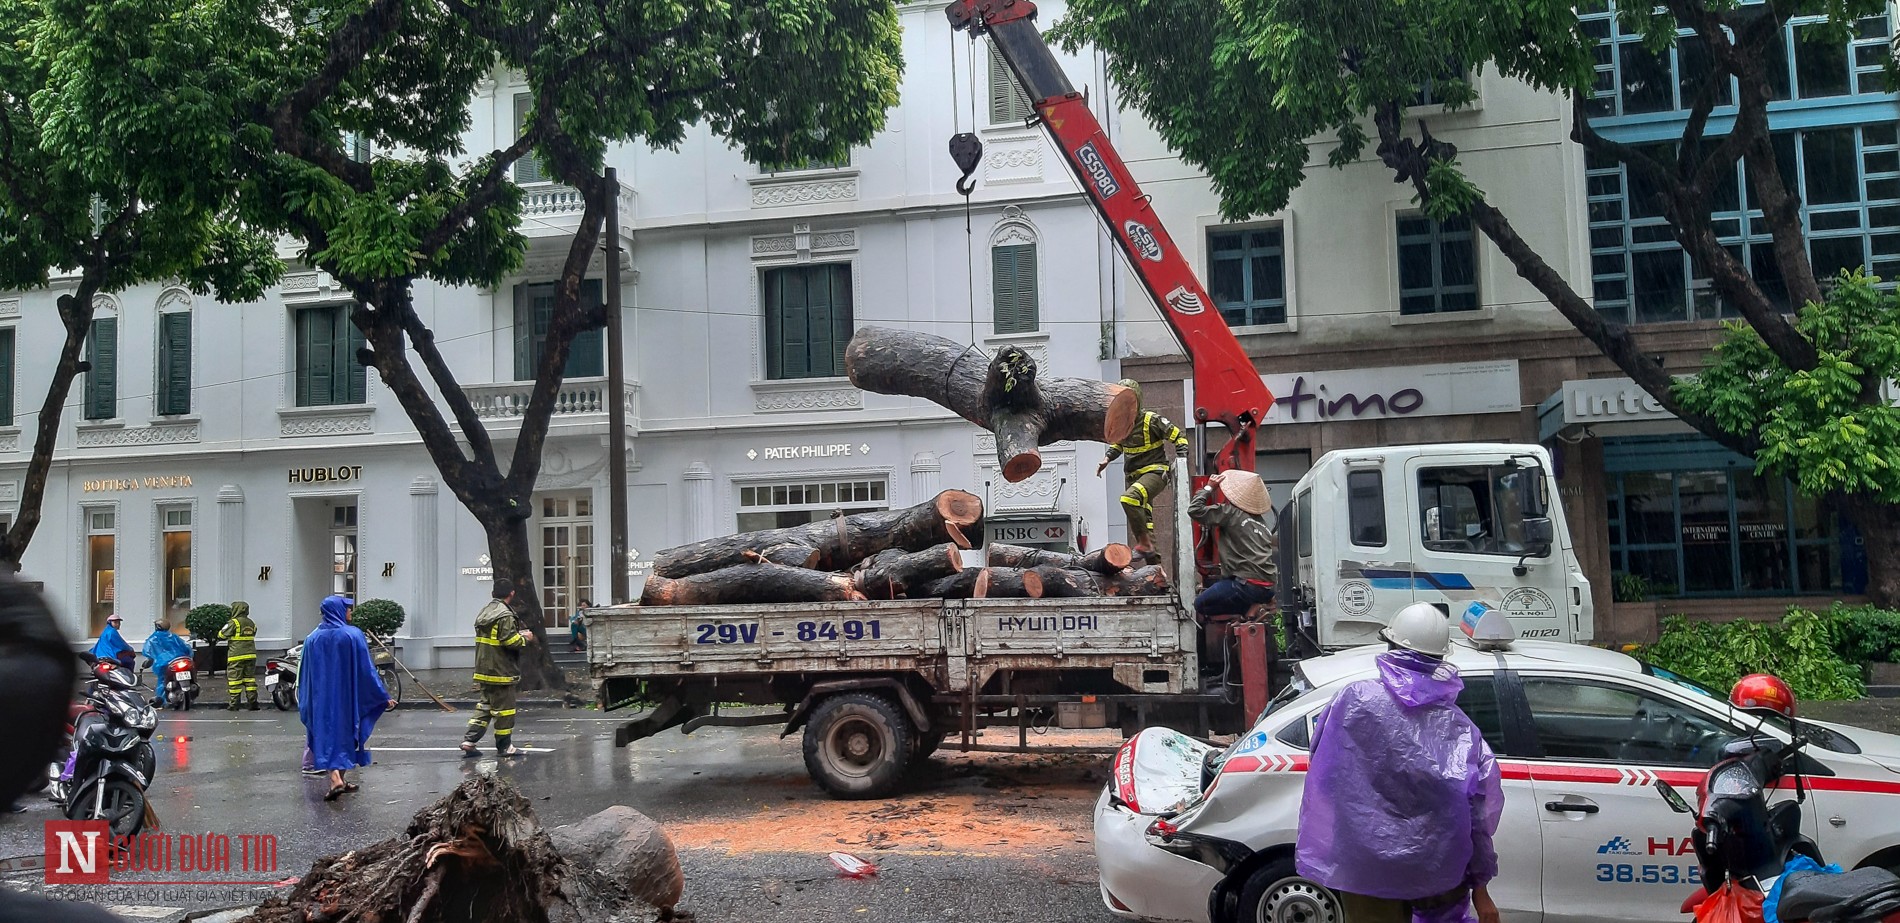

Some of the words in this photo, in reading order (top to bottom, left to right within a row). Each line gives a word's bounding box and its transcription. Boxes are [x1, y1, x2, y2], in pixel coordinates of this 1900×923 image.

[1135, 225, 1158, 255] CSM
[1275, 376, 1423, 419] timo
[765, 447, 799, 459] PATEK
[802, 444, 851, 457] PHILIPPE
[289, 466, 363, 483] HUBLOT
[83, 478, 139, 492] BOTTEGA
[143, 475, 193, 488] VENETA
[995, 527, 1038, 540] HSBC
[1682, 526, 1728, 534] INTERNATIONAL
[1739, 524, 1784, 532] INTERNATIONAL
[462, 567, 480, 575] PATEK
[697, 624, 759, 644] 29V
[797, 620, 880, 641] 8491
